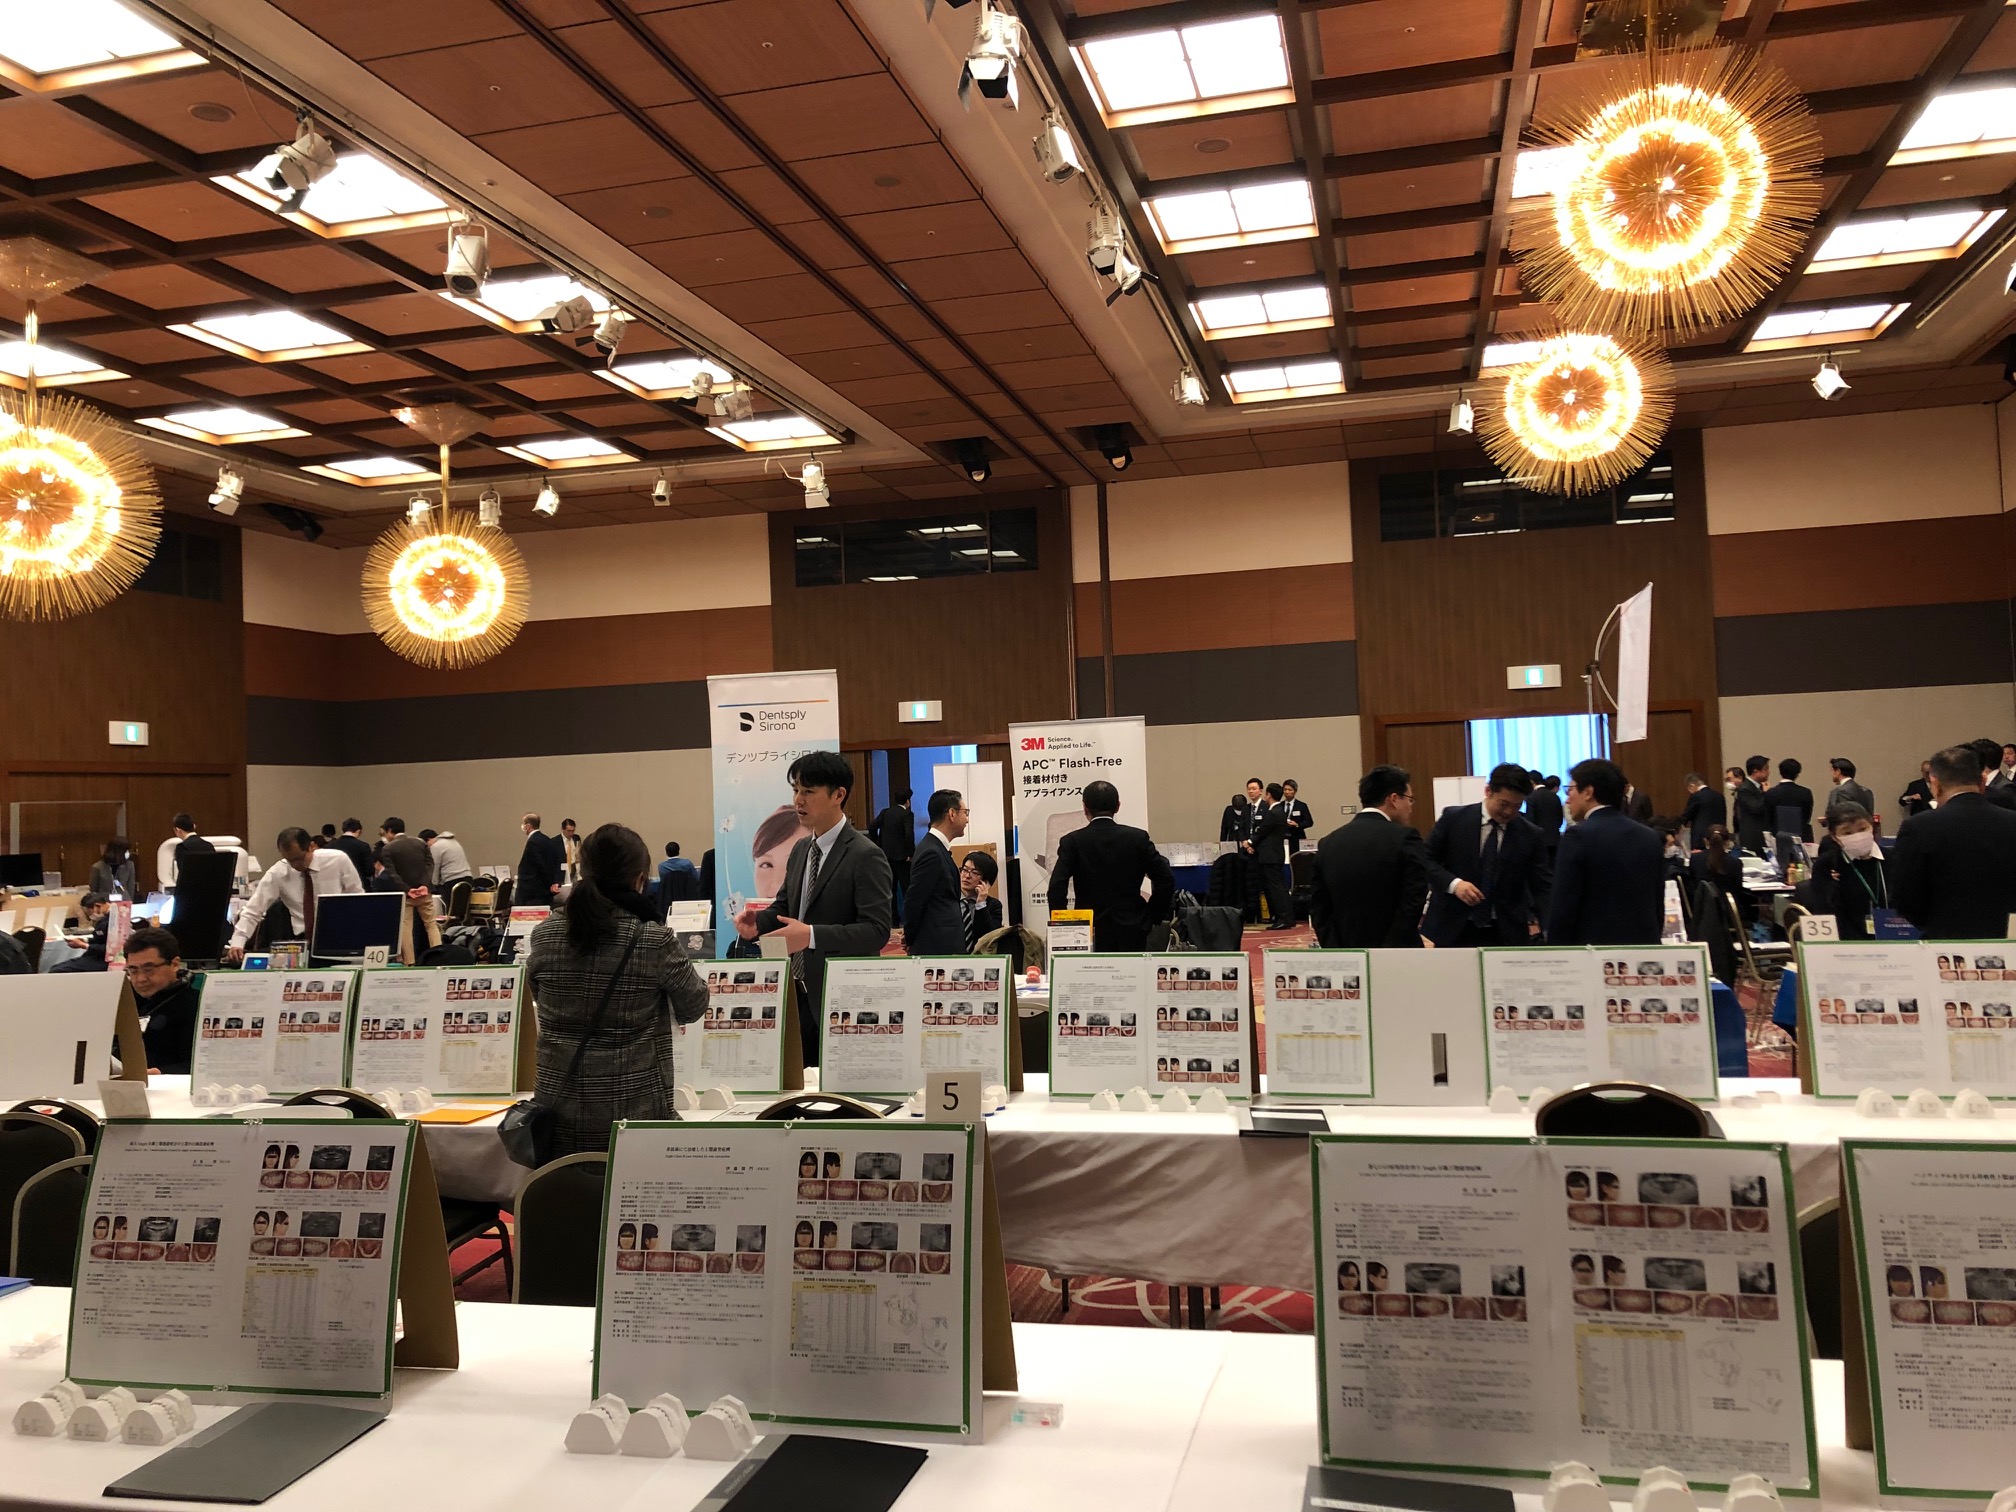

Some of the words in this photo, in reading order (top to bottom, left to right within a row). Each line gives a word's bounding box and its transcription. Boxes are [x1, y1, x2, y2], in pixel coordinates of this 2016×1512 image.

[759, 709, 807, 721] Dentsply
[759, 721, 796, 732] Sirona
[1021, 737, 1045, 751] 3M
[1059, 756, 1123, 769] Flash-Free
[1023, 773, 1068, 785] 接着材付き
[1806, 920, 1832, 936] 35
[366, 950, 385, 964] 40
[942, 1082, 959, 1111] 5
